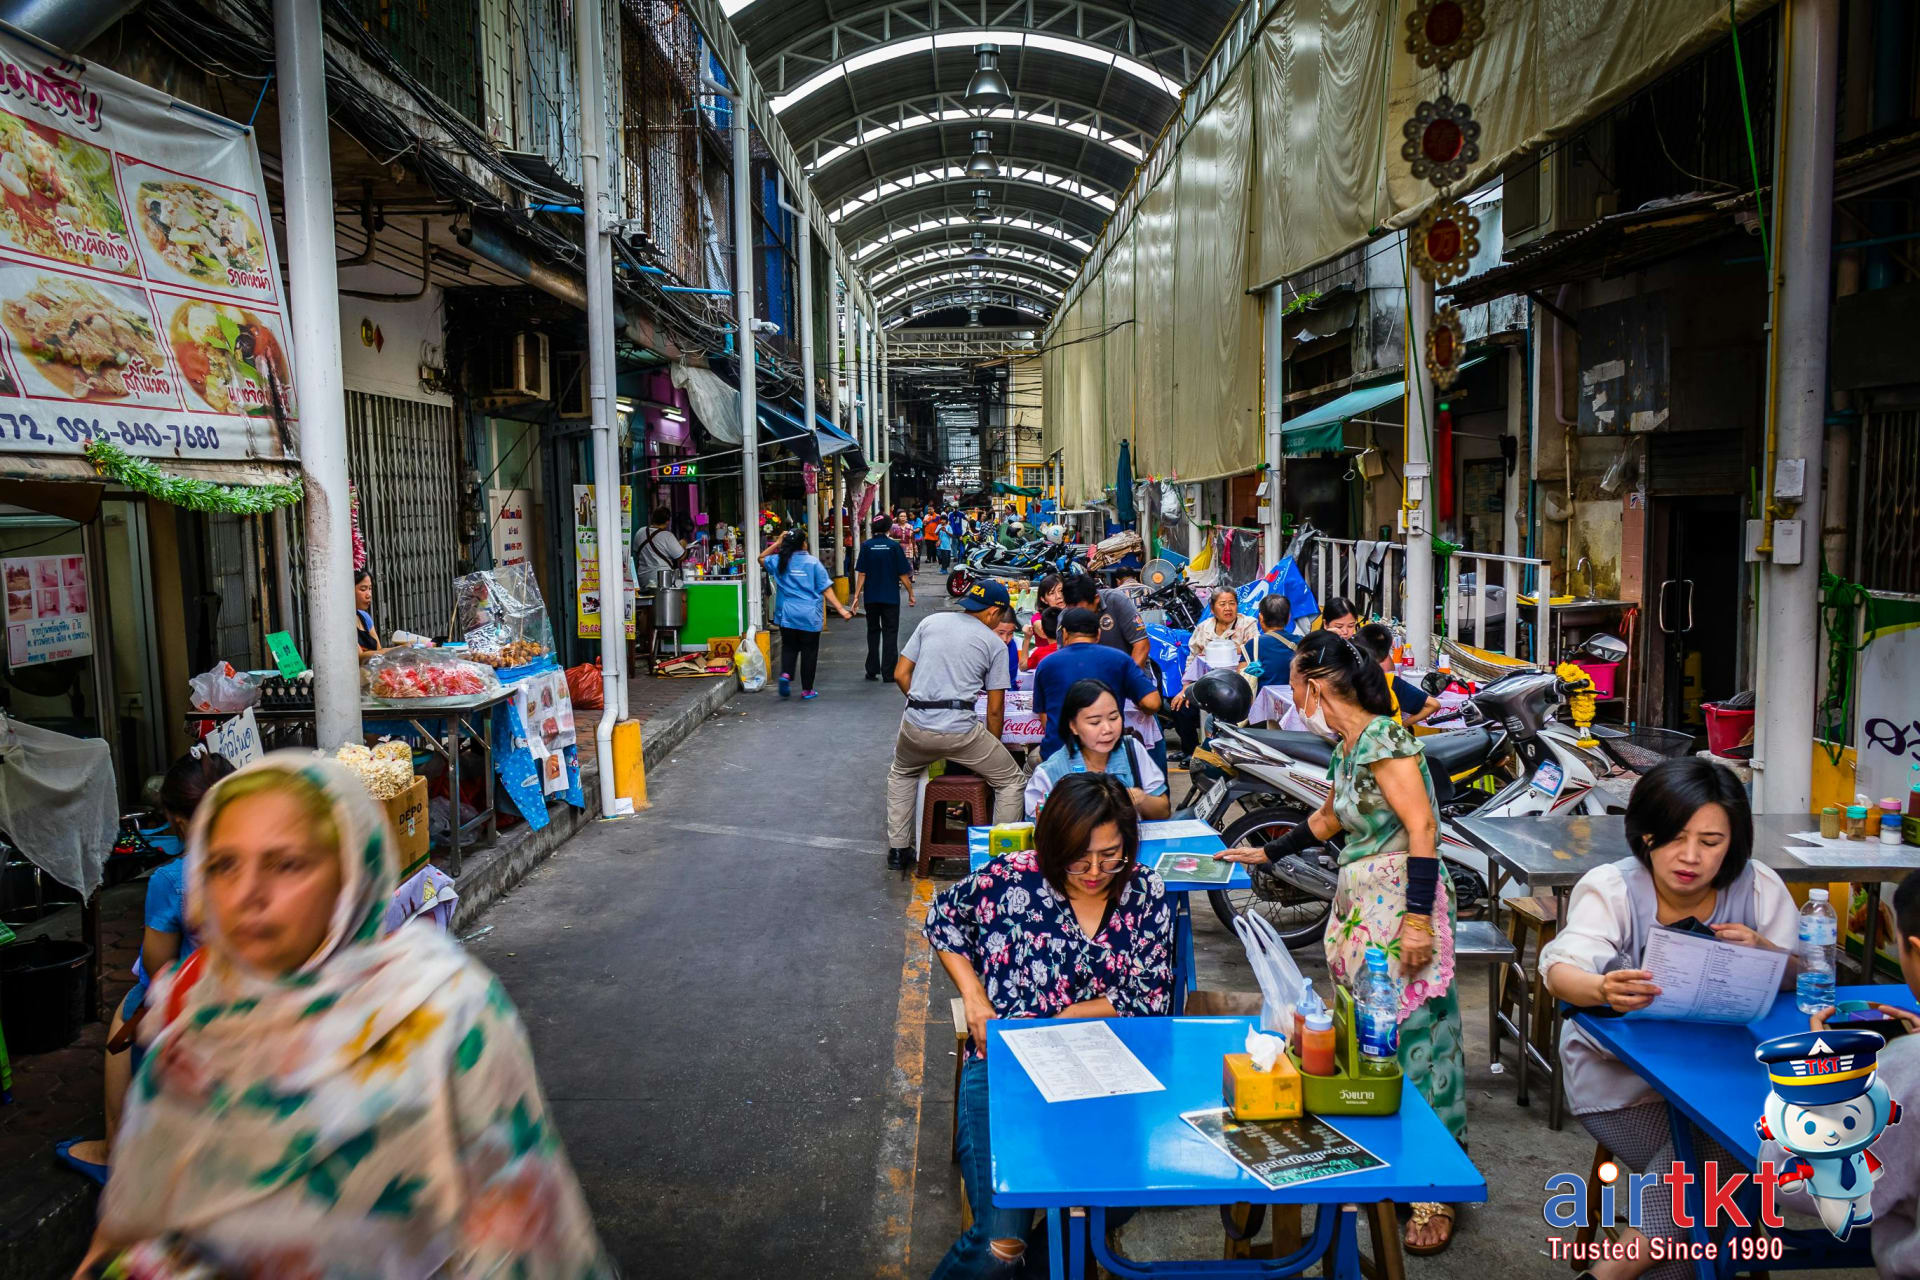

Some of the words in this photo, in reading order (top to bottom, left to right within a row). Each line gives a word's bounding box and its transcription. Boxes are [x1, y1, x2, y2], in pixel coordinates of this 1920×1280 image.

[56, 219, 129, 268] ข้าวผัดกุ้ง
[227, 268, 271, 291] ราดหน้า
[121, 360, 170, 400] สุกี้แห้ง
[0, 414, 54, 445] 72,
[57, 416, 220, 449] 096-840-7680
[663, 464, 696, 475] OPEN
[399, 803, 423, 825] DEPO
